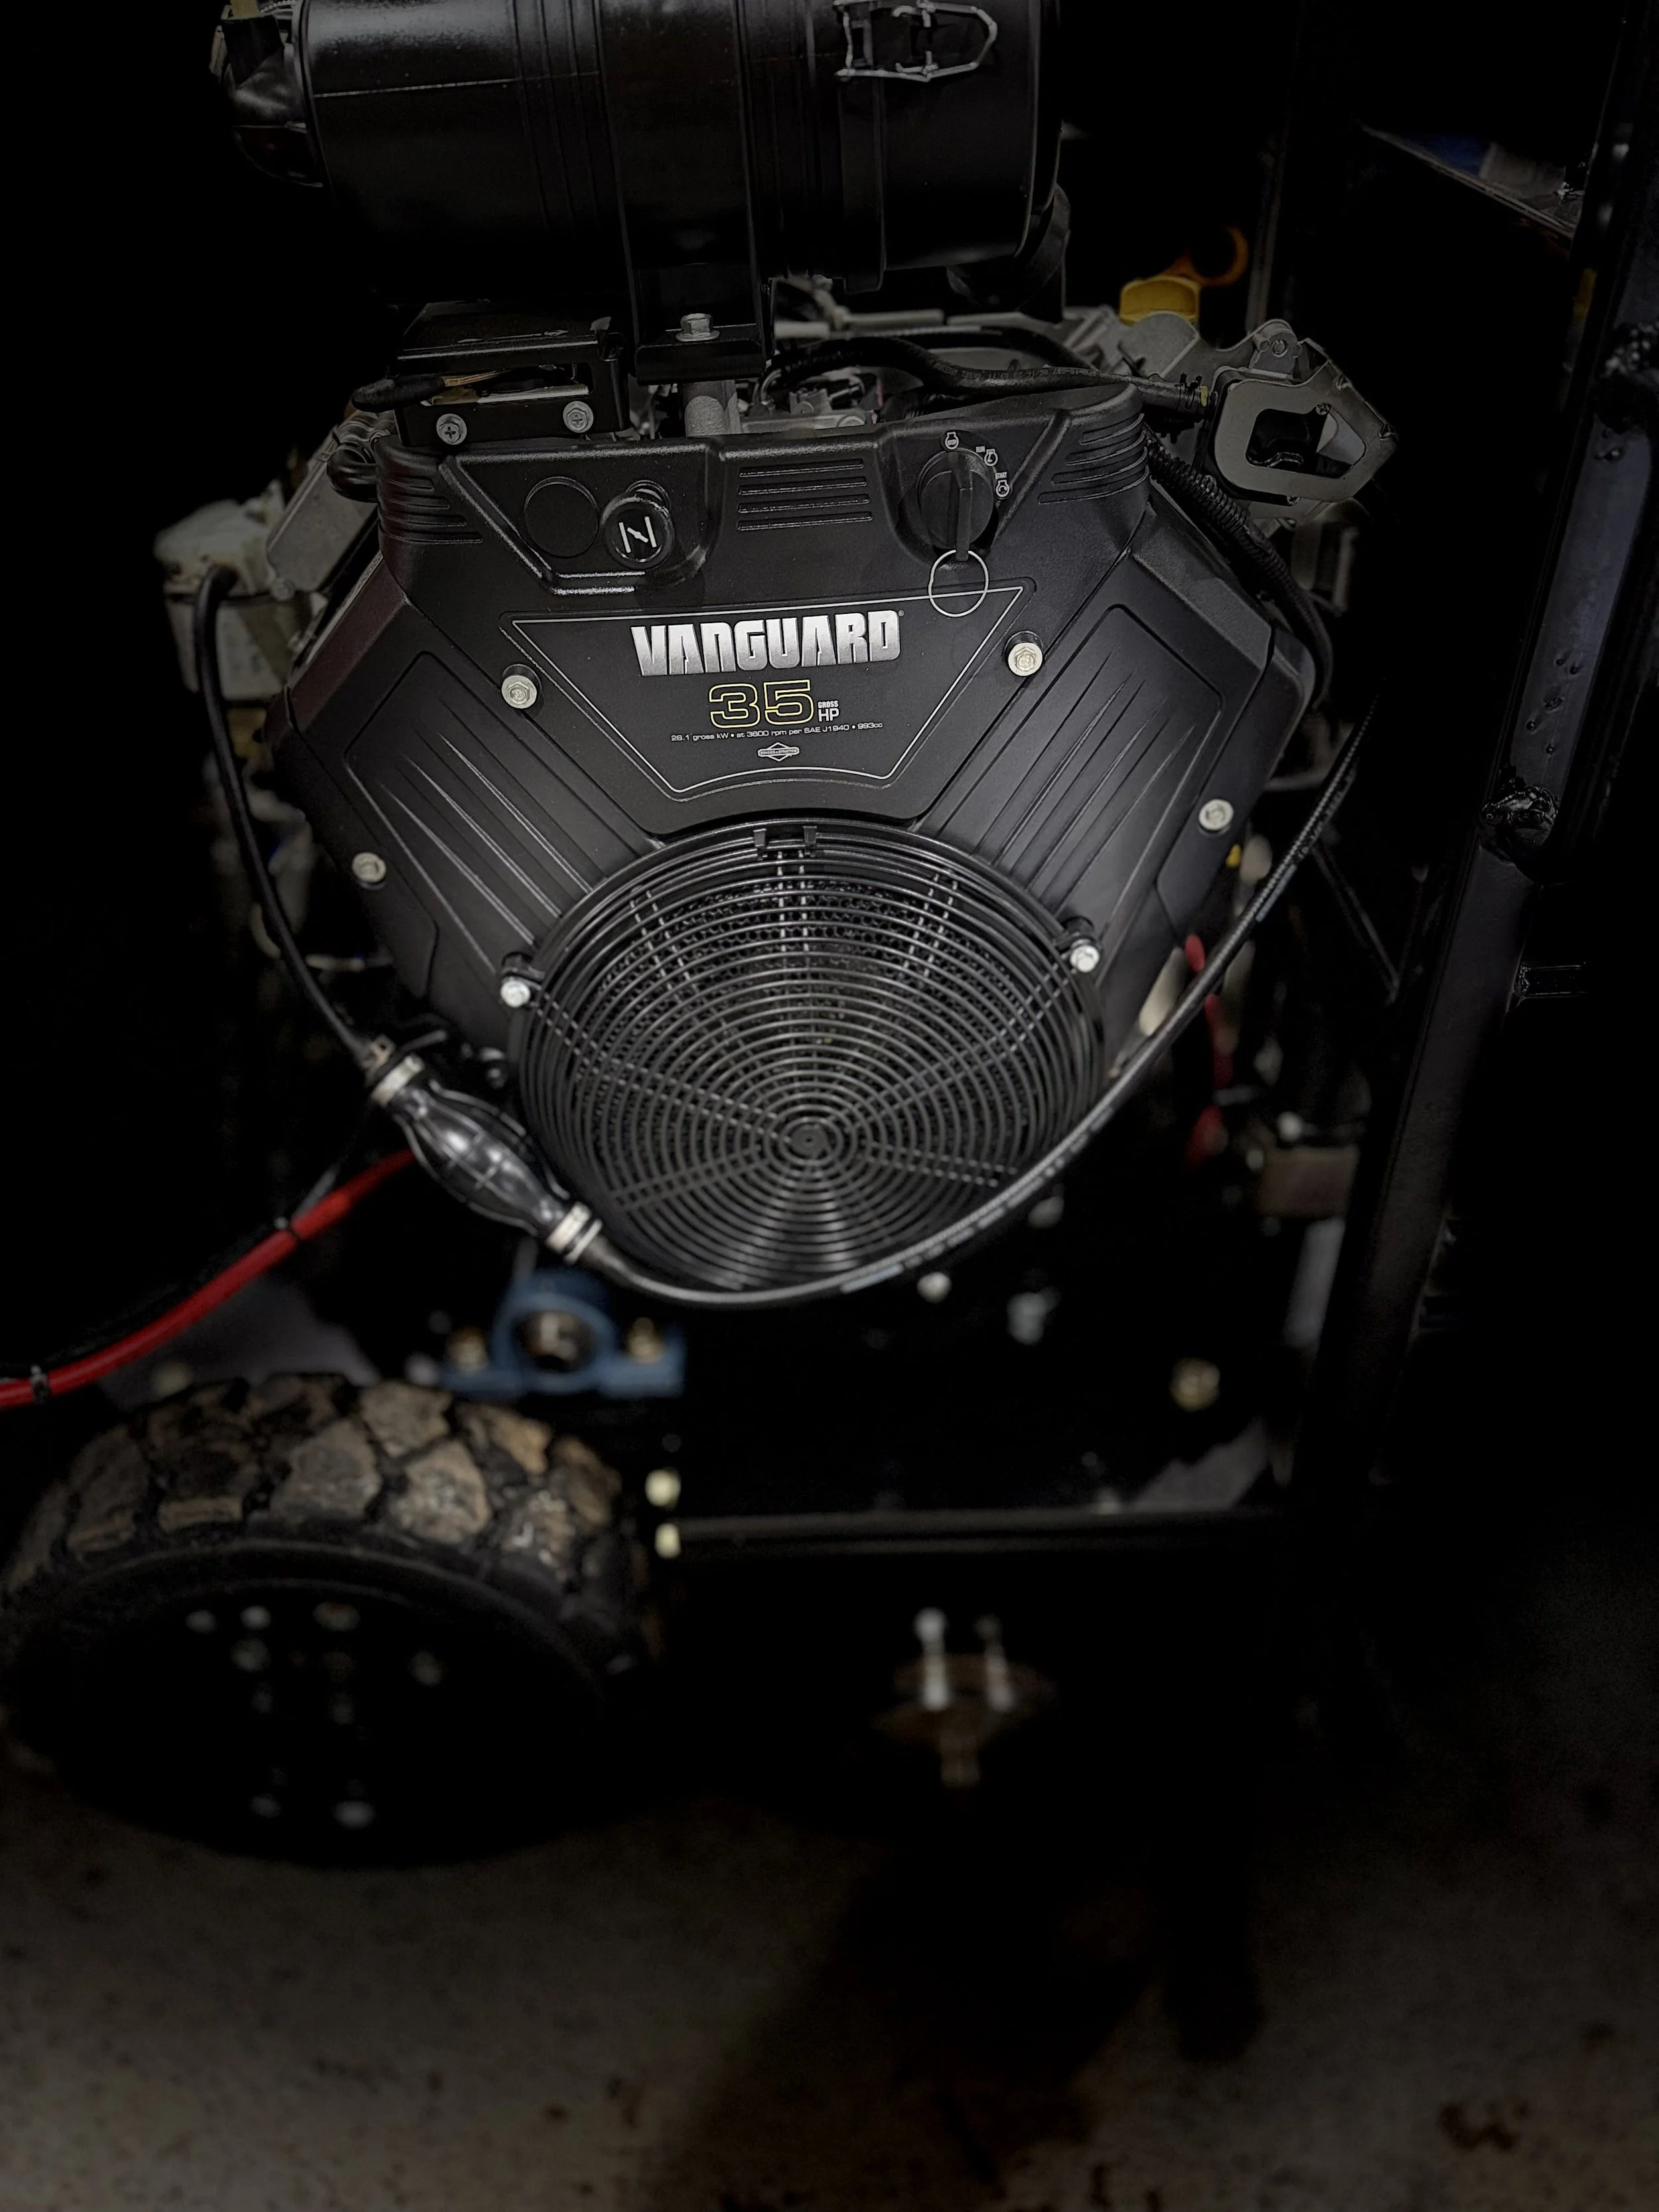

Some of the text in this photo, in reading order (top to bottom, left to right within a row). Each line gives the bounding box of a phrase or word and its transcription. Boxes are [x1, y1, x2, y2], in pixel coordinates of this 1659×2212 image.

[630, 610, 901, 676] VANGUARD
[709, 679, 814, 729] 35
[818, 700, 839, 709] GROSS
[818, 708, 839, 722] HP
